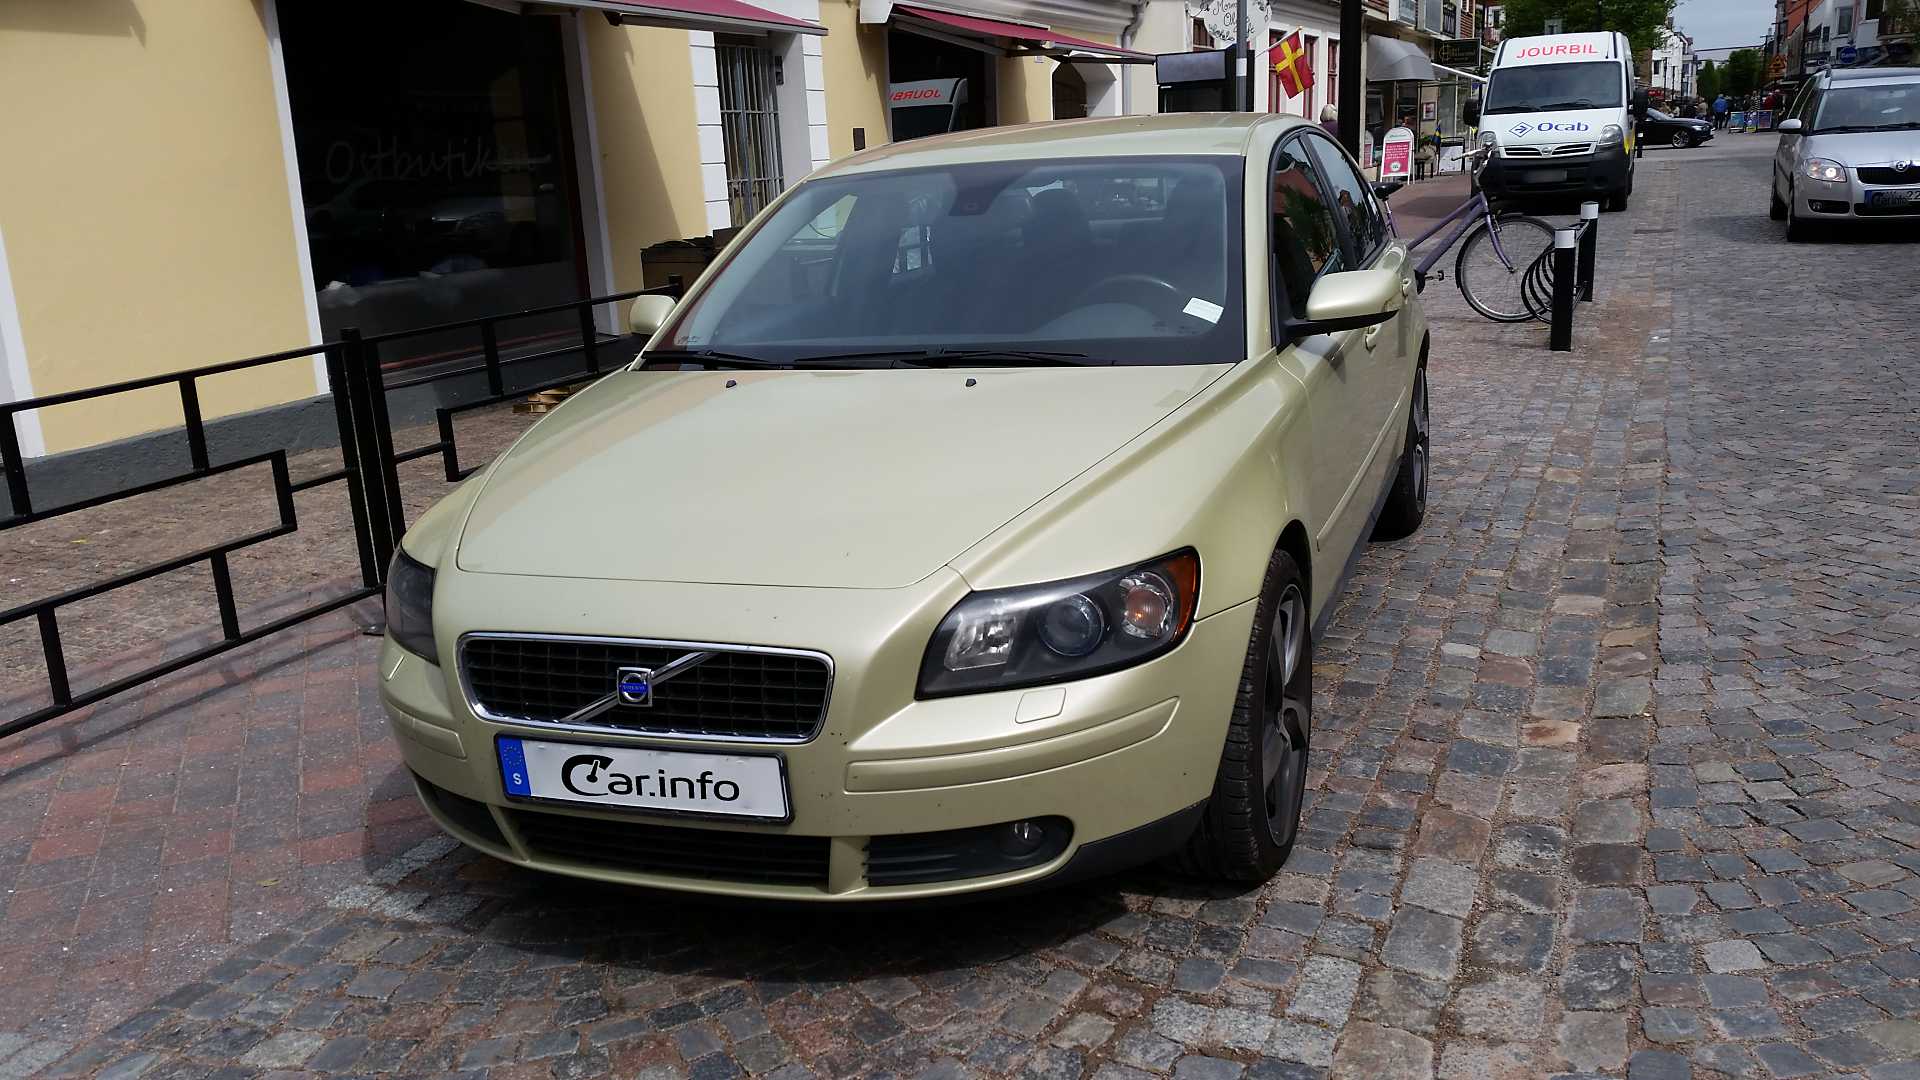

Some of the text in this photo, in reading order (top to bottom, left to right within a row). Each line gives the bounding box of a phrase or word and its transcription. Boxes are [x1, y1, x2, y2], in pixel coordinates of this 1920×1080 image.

[1516, 44, 1599, 58] JOURBIL
[1537, 122, 1589, 131] Ocab
[512, 772, 523, 785] S
